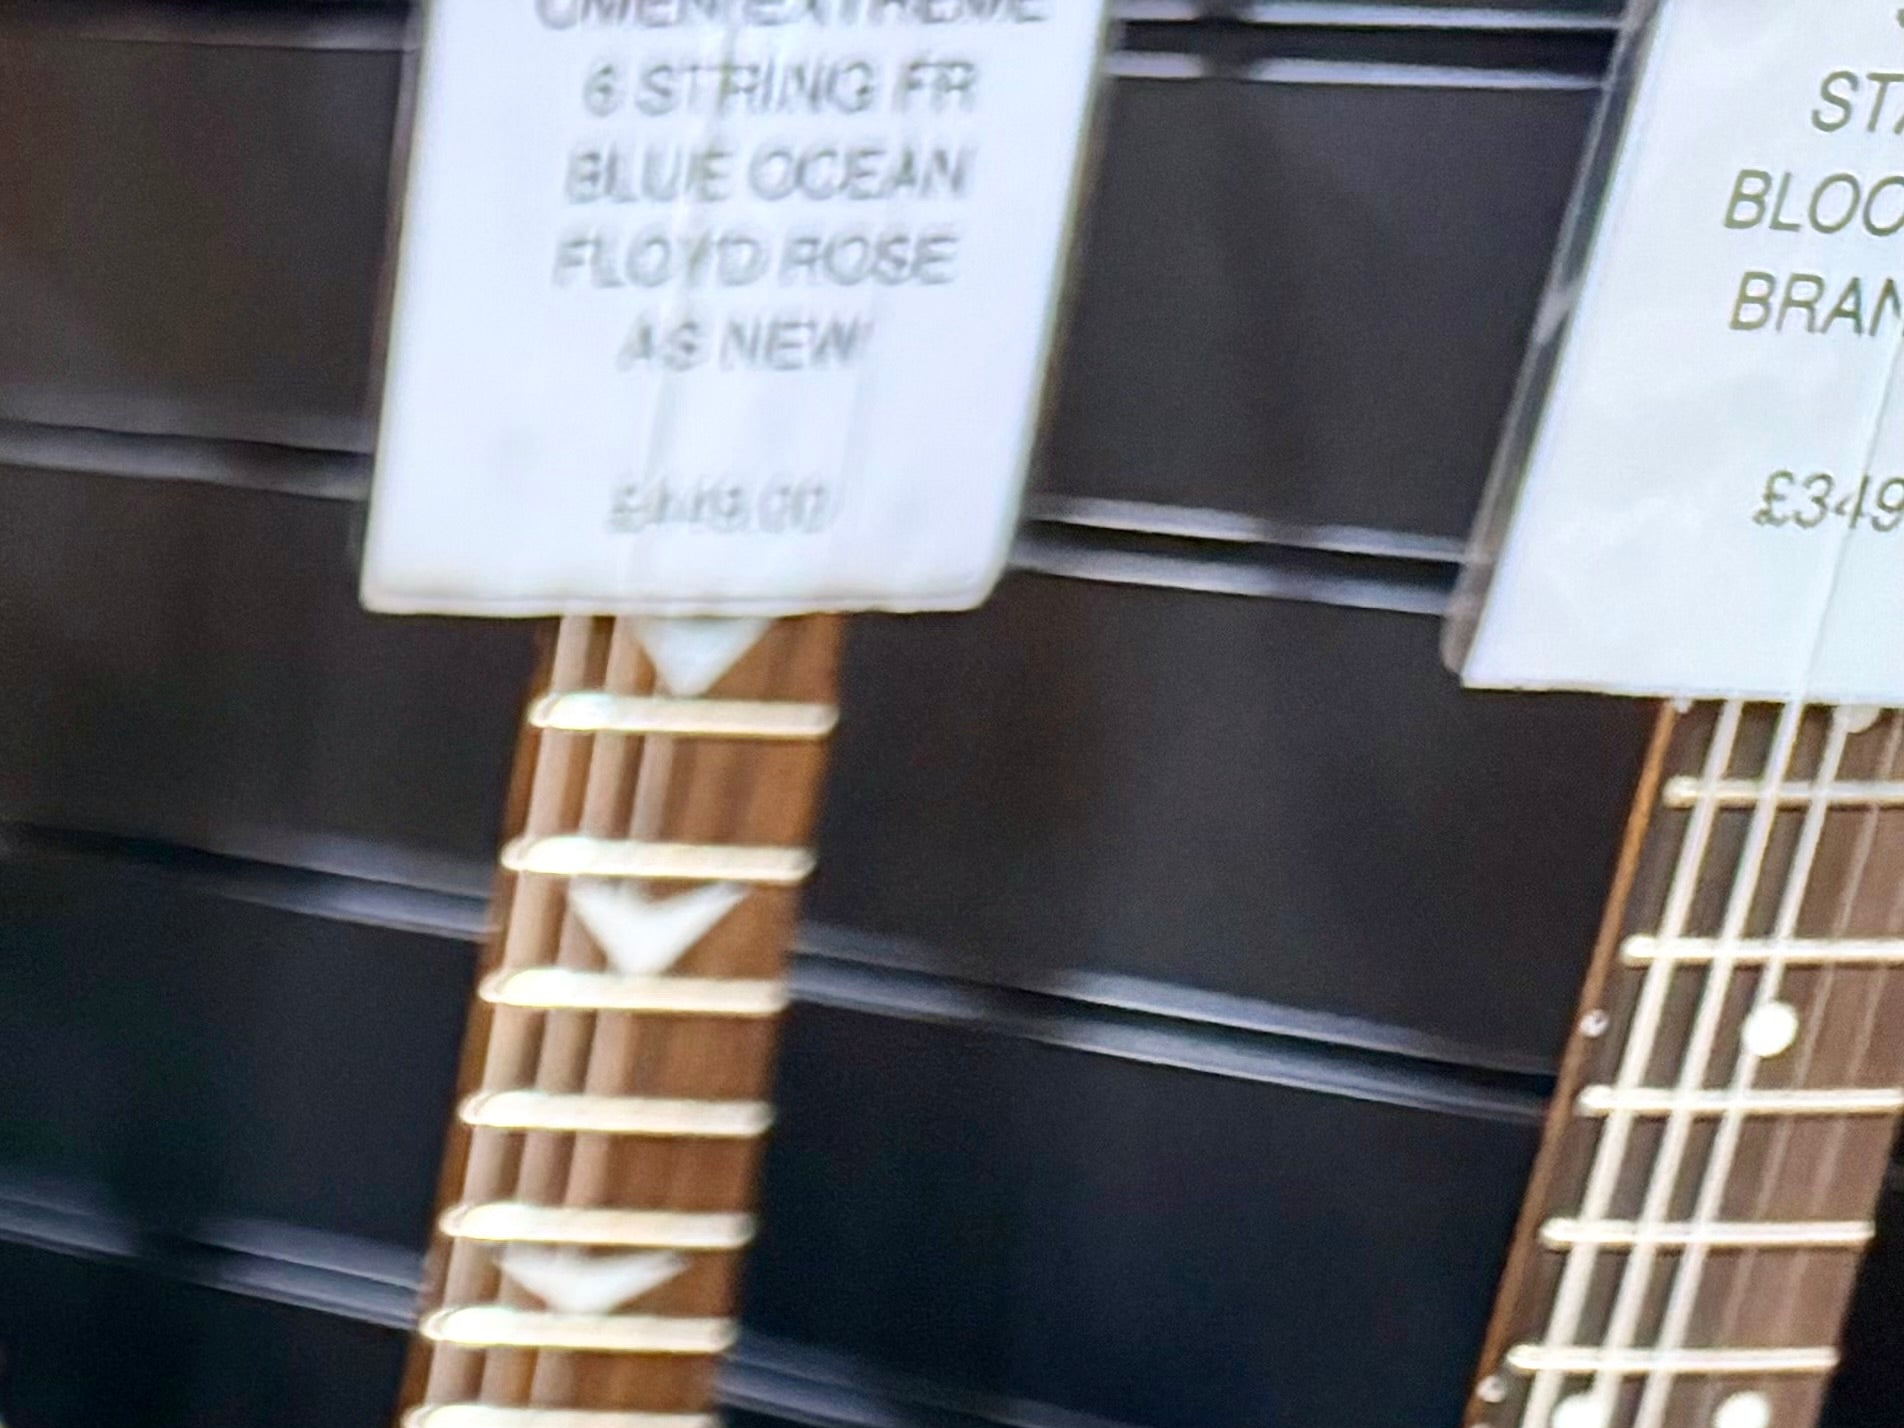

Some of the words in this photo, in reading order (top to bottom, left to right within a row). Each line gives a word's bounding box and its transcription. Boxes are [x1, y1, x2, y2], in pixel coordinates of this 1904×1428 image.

[585, 63, 622, 116] 6
[634, 62, 876, 115] STRING
[896, 60, 979, 112] FR
[1810, 70, 1904, 134] ST
[565, 149, 735, 203] BLUE
[747, 148, 977, 202] OCEAN
[552, 232, 769, 288] FLOYD
[778, 229, 961, 286] ROSE
[618, 315, 705, 370] AS
[719, 314, 872, 370] NEW
